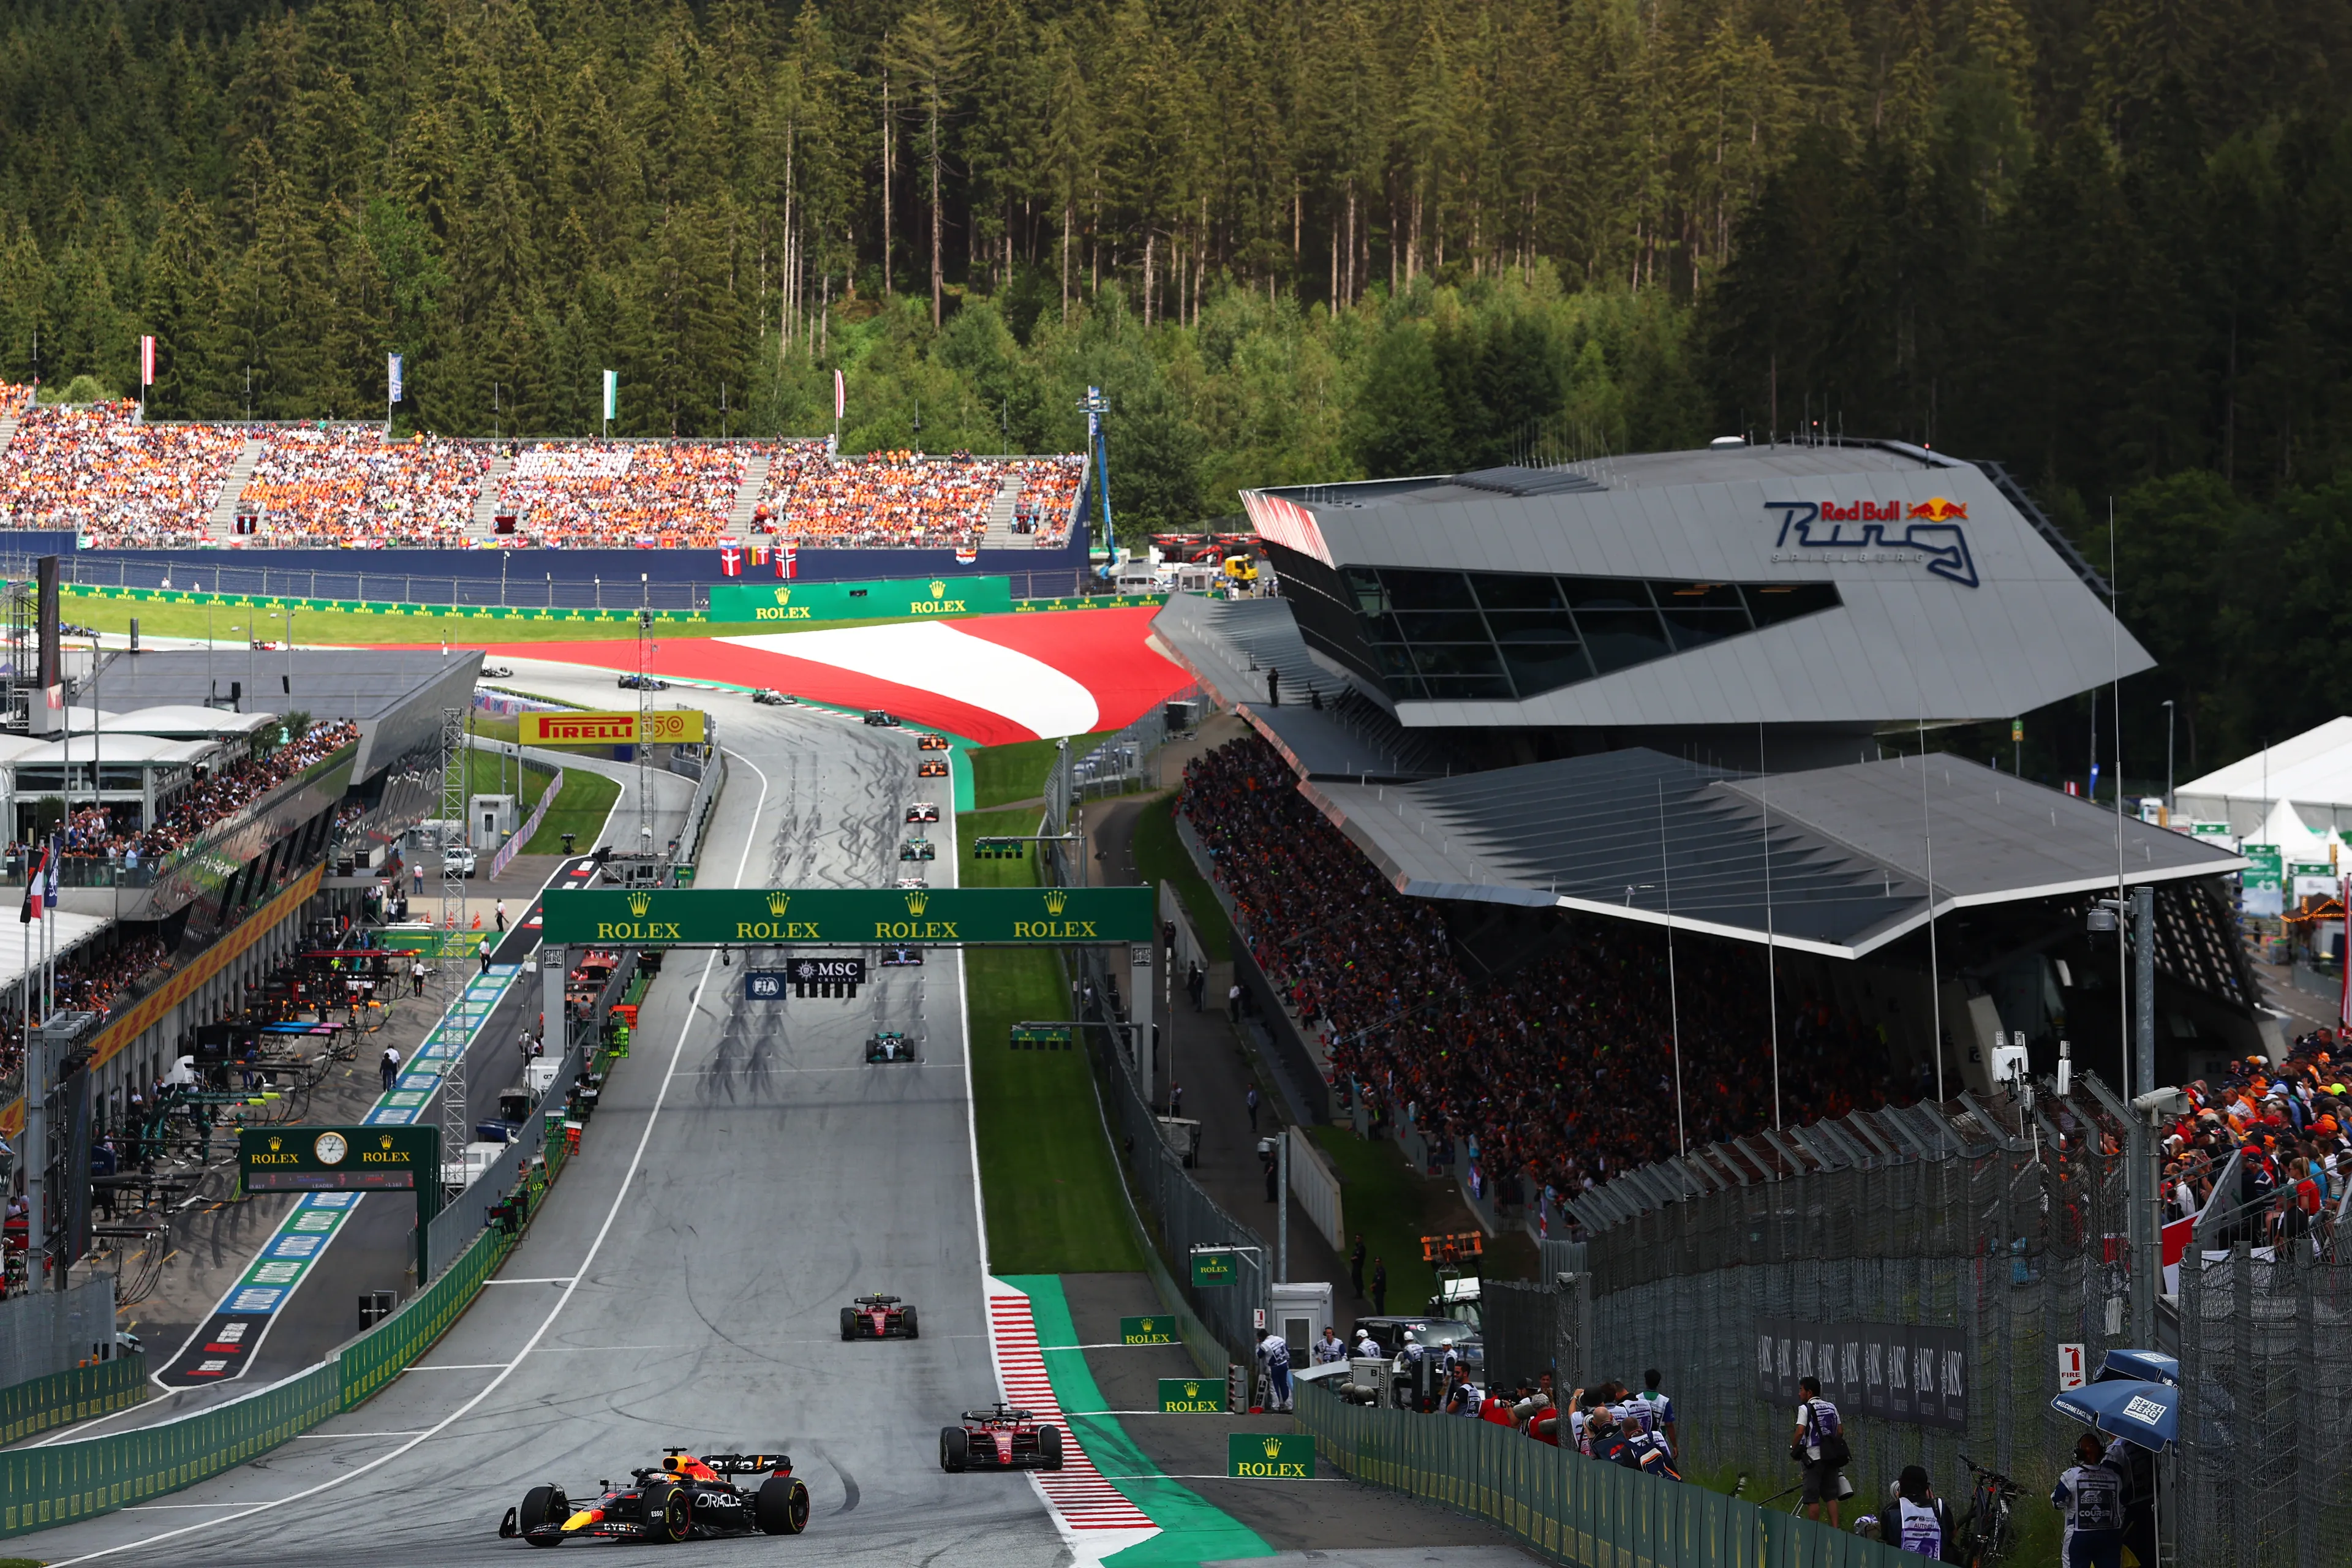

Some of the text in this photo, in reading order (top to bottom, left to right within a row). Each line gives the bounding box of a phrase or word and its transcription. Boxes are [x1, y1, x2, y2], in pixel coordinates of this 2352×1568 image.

[1822, 500, 1899, 521] Red Bull
[1765, 502, 1979, 588] Ring
[1771, 553, 1924, 563] SPIELBERG
[756, 607, 811, 619] ROLEX
[911, 601, 966, 614] ROLEX
[539, 717, 633, 738] PIRELLI
[597, 923, 681, 939] ROLEX
[736, 922, 820, 938] ROLEX
[875, 922, 959, 938] ROLEX
[1014, 921, 1097, 938] ROLEX
[818, 963, 858, 975] MSC
[251, 1154, 299, 1164] ROLEX
[363, 1152, 410, 1162] ROLEX
[1125, 1334, 1169, 1344] ROLEX
[1762, 1335, 1773, 1374] MSC
[1846, 1342, 1859, 1383] MSC
[1823, 1344, 1835, 1383] MSC
[1870, 1343, 1882, 1385] MSC
[1893, 1346, 1906, 1389] MSC
[1920, 1348, 1934, 1392] MSC
[1948, 1351, 1963, 1396] MSC
[1166, 1401, 1218, 1412] ROLEX
[2056, 1400, 2077, 1413] WELCOME
[2130, 1403, 2157, 1418] BERG
[2135, 1398, 2164, 1412] SPIEL
[1238, 1463, 1306, 1476] ROLEX
[695, 1493, 742, 1508] ORACLE
